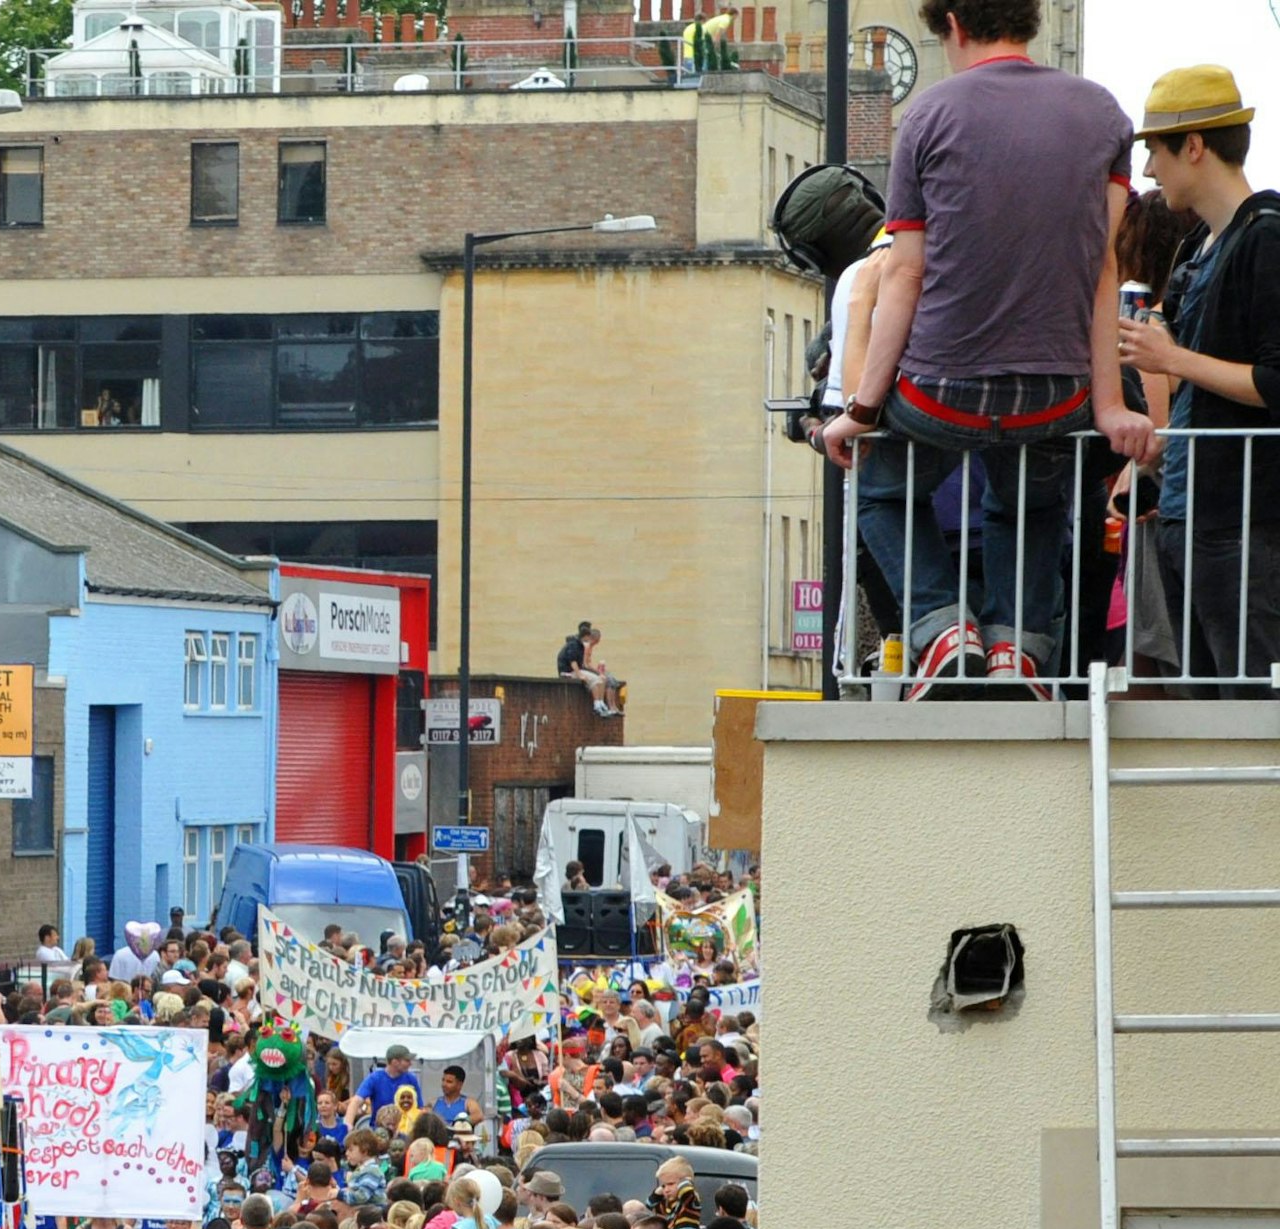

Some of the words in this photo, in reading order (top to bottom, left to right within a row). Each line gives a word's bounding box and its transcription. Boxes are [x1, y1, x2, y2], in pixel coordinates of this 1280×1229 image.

[330, 601, 391, 635] PorschMode
[2, 731, 13, 740] sq
[432, 730, 450, 740] 0117
[473, 730, 492, 740] 3117
[280, 974, 310, 1001] and
[314, 988, 432, 1028] Childrens
[300, 951, 356, 988] Pauls
[358, 975, 457, 1012] Nursery
[464, 951, 538, 999] School
[2, 1031, 121, 1095] Primary
[102, 1136, 153, 1158] each
[155, 1143, 203, 1178] other
